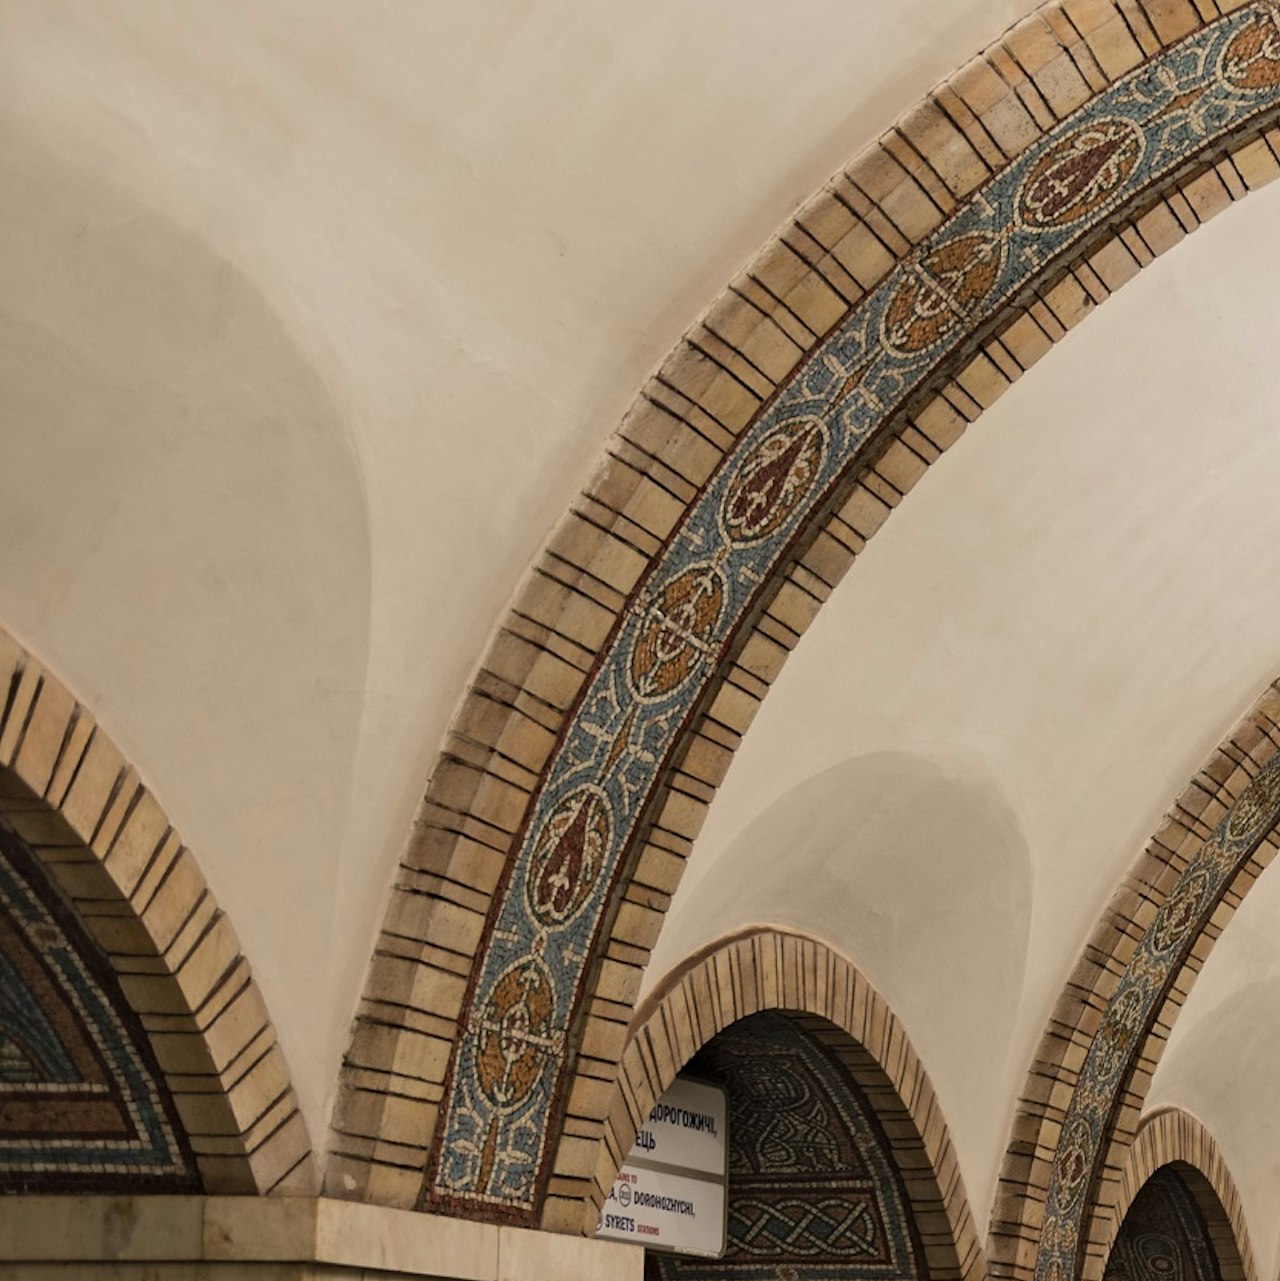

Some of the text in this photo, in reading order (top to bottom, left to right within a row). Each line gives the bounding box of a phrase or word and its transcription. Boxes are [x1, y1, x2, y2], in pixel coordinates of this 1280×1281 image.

[649, 1104, 718, 1138] ДОРОГОЖИЧІ,
[634, 1191, 695, 1219] DOROHOZHYCHI,
[605, 1214, 635, 1232] SYRETS
